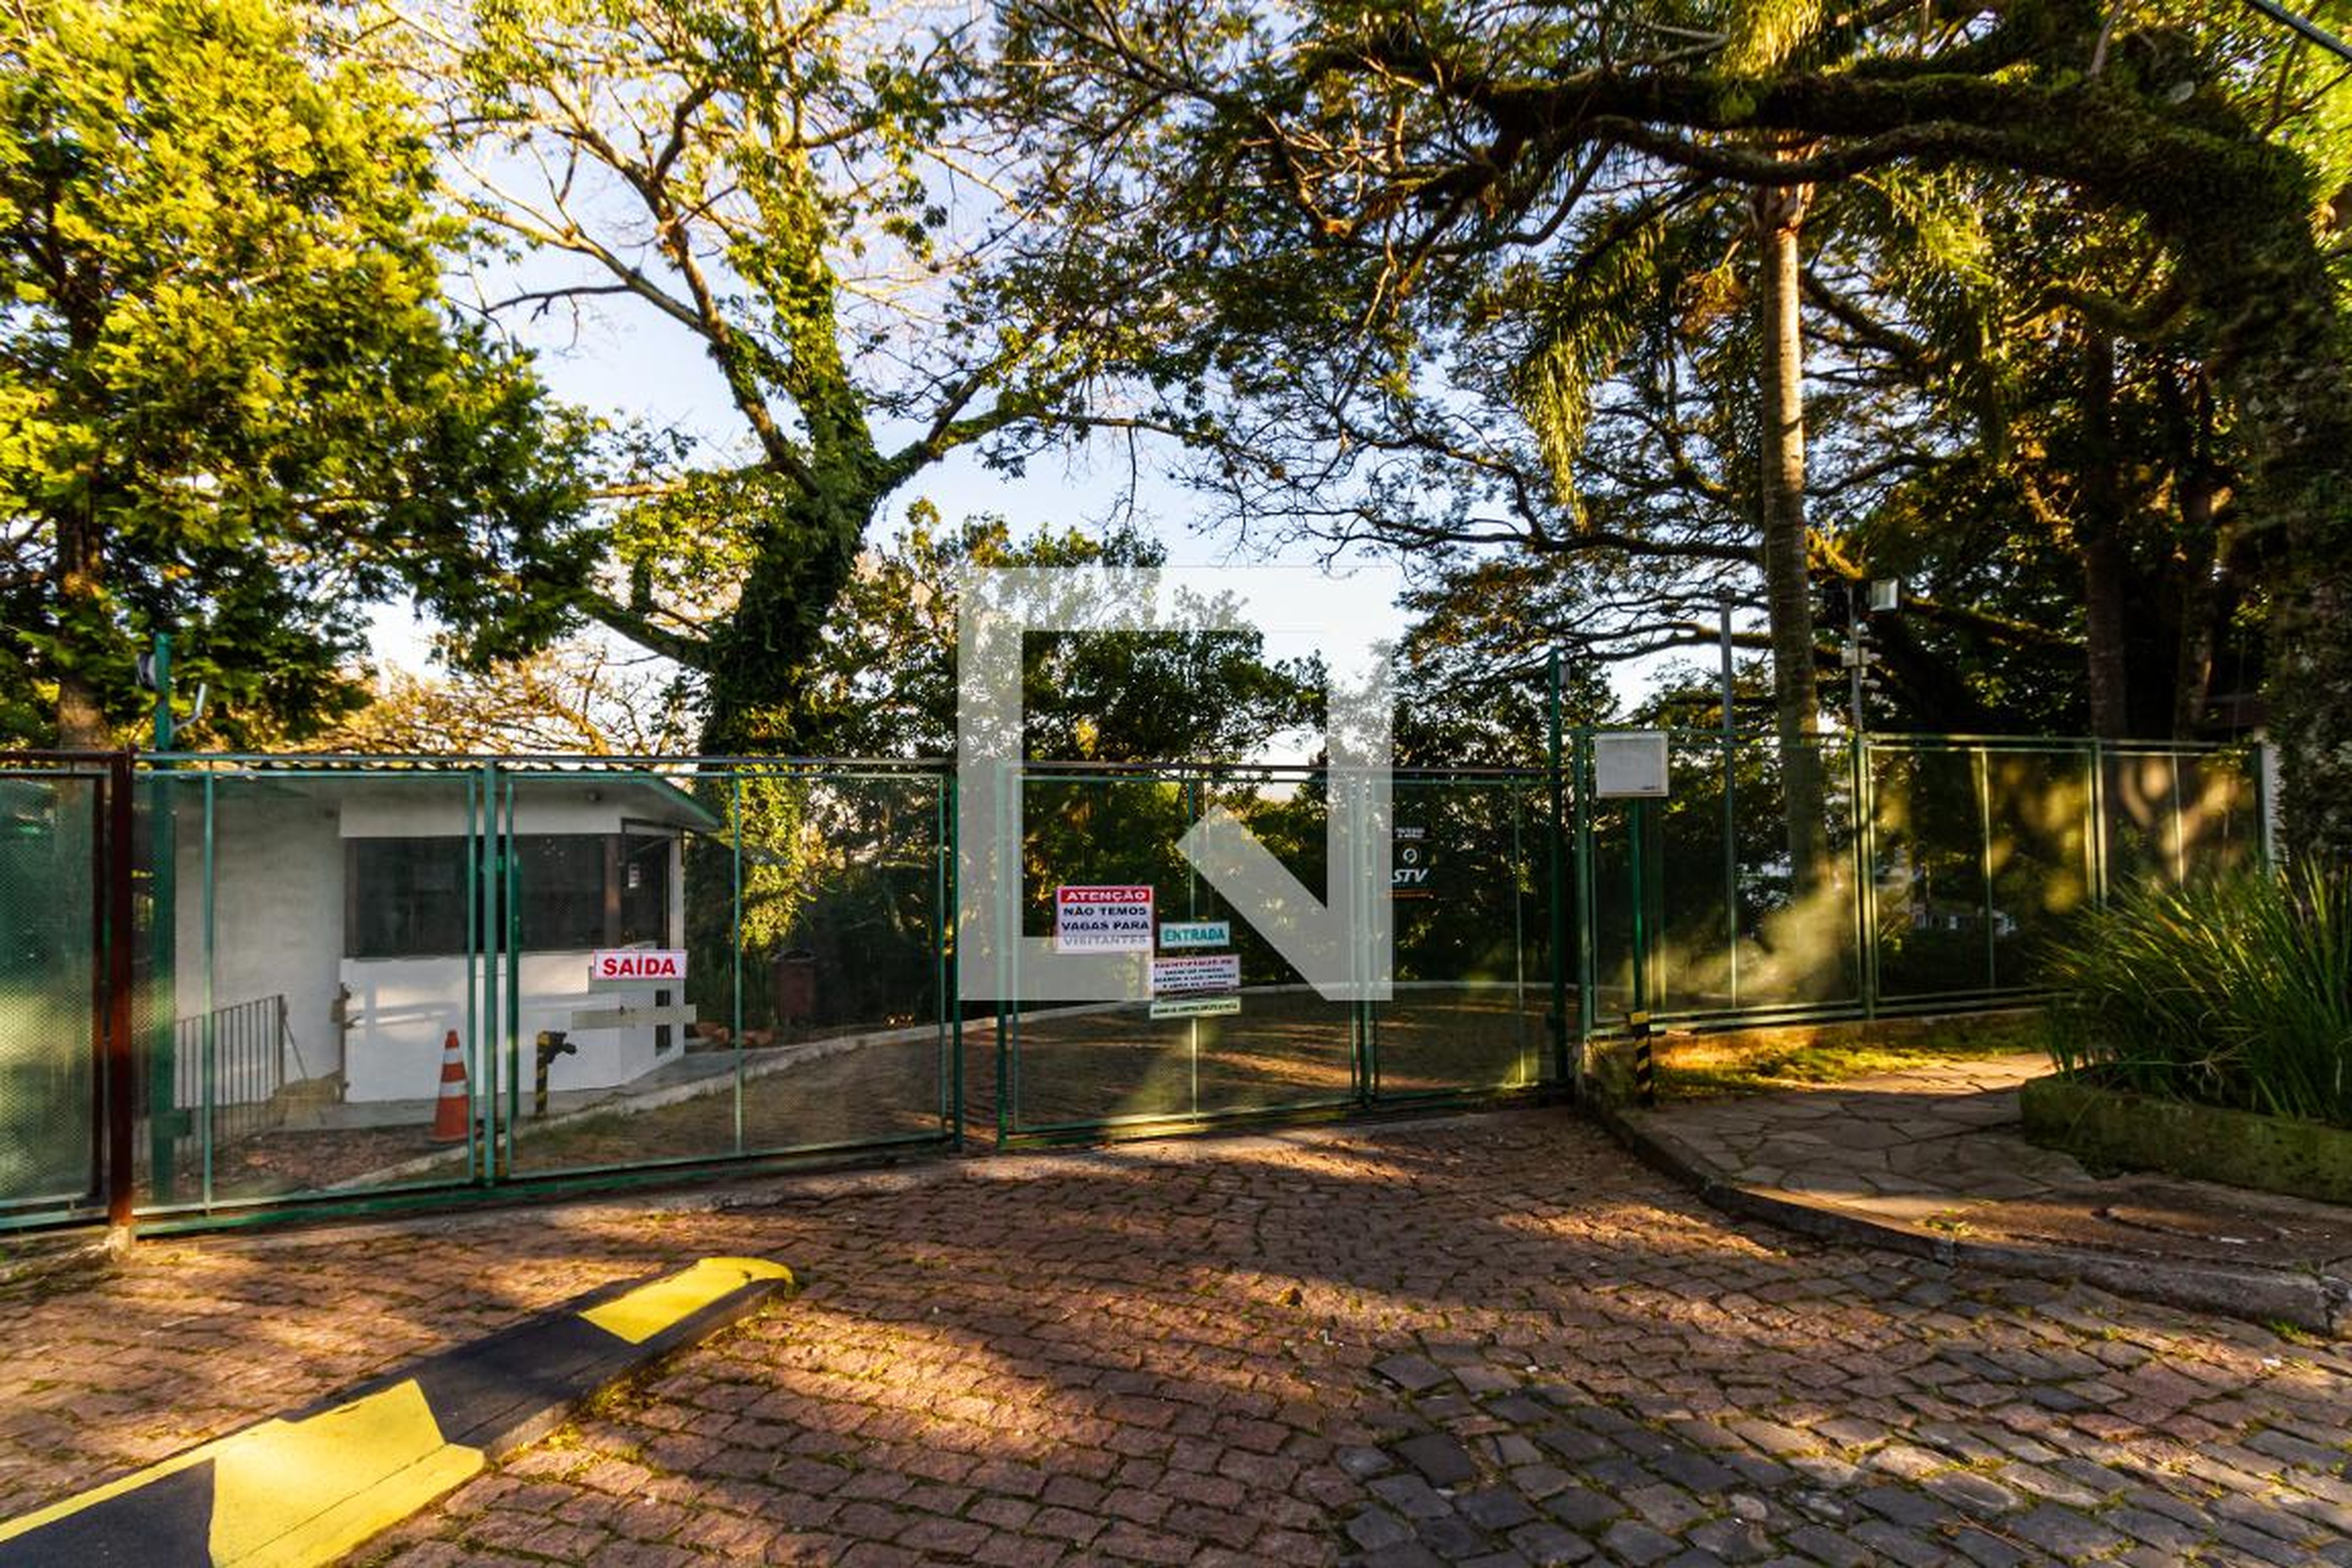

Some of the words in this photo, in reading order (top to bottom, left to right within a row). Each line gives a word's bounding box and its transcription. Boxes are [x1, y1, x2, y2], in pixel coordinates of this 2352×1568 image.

[1390, 867, 1430, 883] STV
[1066, 889, 1147, 902] ATENÇÃO
[1063, 904, 1095, 916] NÃO
[1099, 906, 1147, 916] TEMOS
[1061, 921, 1109, 931] VAGAS
[1114, 920, 1149, 930] PARA
[1064, 934, 1147, 946] VISITANTES
[1164, 928, 1226, 942] ENTRADA
[603, 956, 676, 975] SAÍDA
